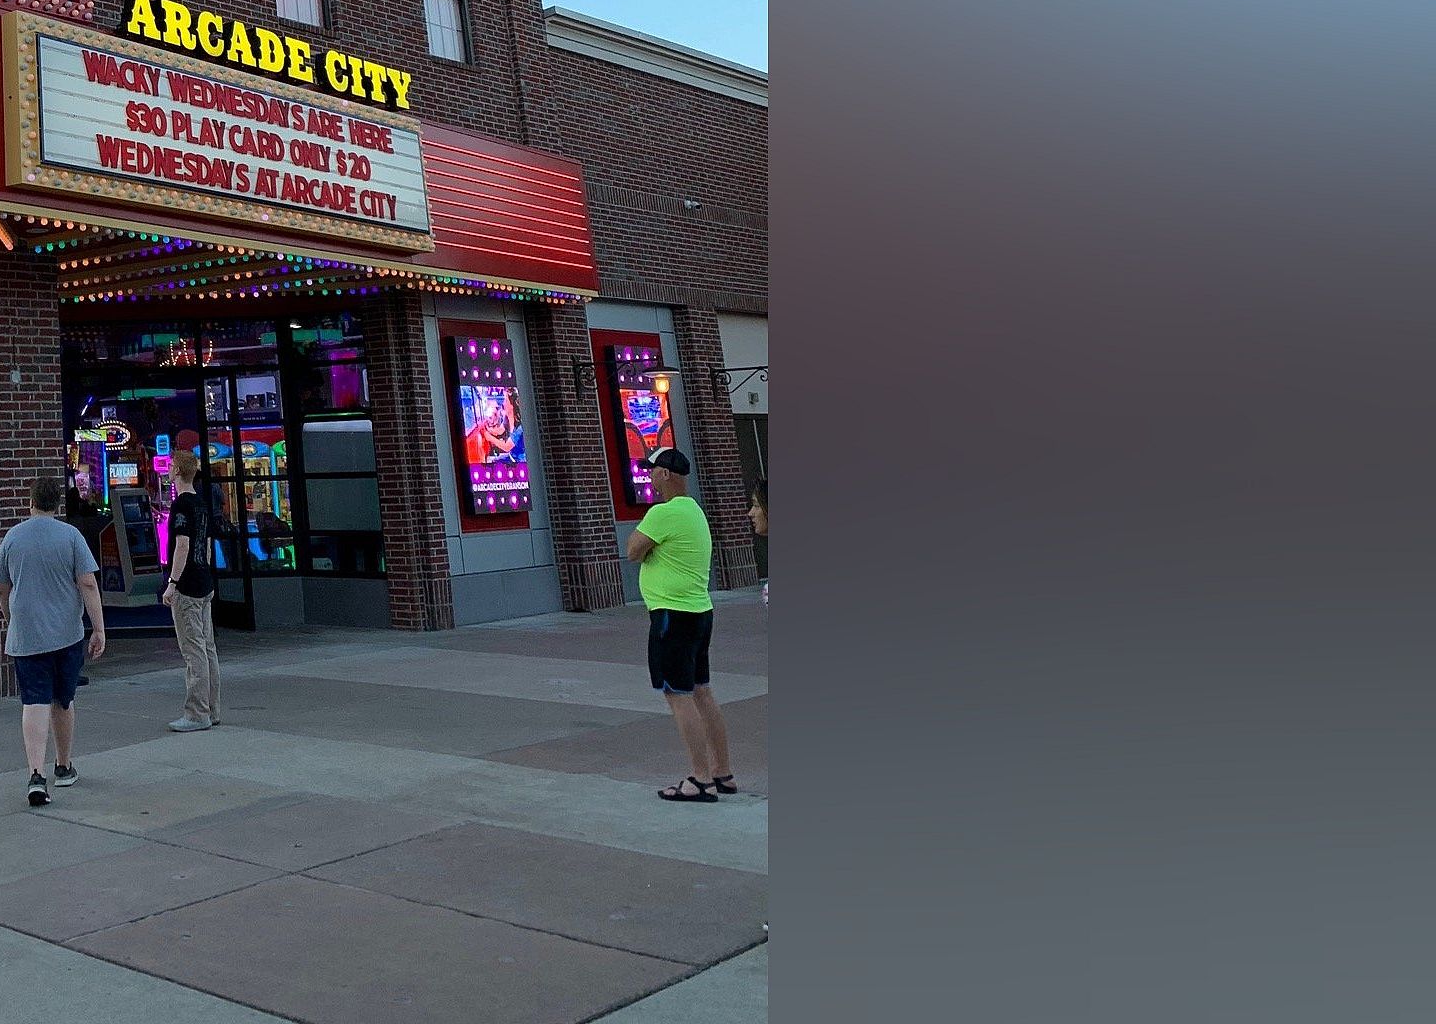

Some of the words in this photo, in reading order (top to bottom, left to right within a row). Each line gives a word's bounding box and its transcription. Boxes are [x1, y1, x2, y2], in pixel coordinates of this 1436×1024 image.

[82, 49, 161, 97] WACKY
[166, 71, 305, 132] WEDNESDAYS
[307, 108, 345, 143] ARE
[348, 118, 394, 155] HERE
[324, 50, 412, 111] CITY
[96, 133, 251, 193] WEDNESDAYS
[253, 167, 280, 199] AT
[281, 172, 358, 215] ARCADE
[359, 189, 397, 221] CITY
[125, 100, 168, 137] $30
[171, 110, 226, 150] PLAY
[228, 124, 285, 162] CARD
[289, 139, 332, 173] ONLY
[335, 149, 372, 182] $20
